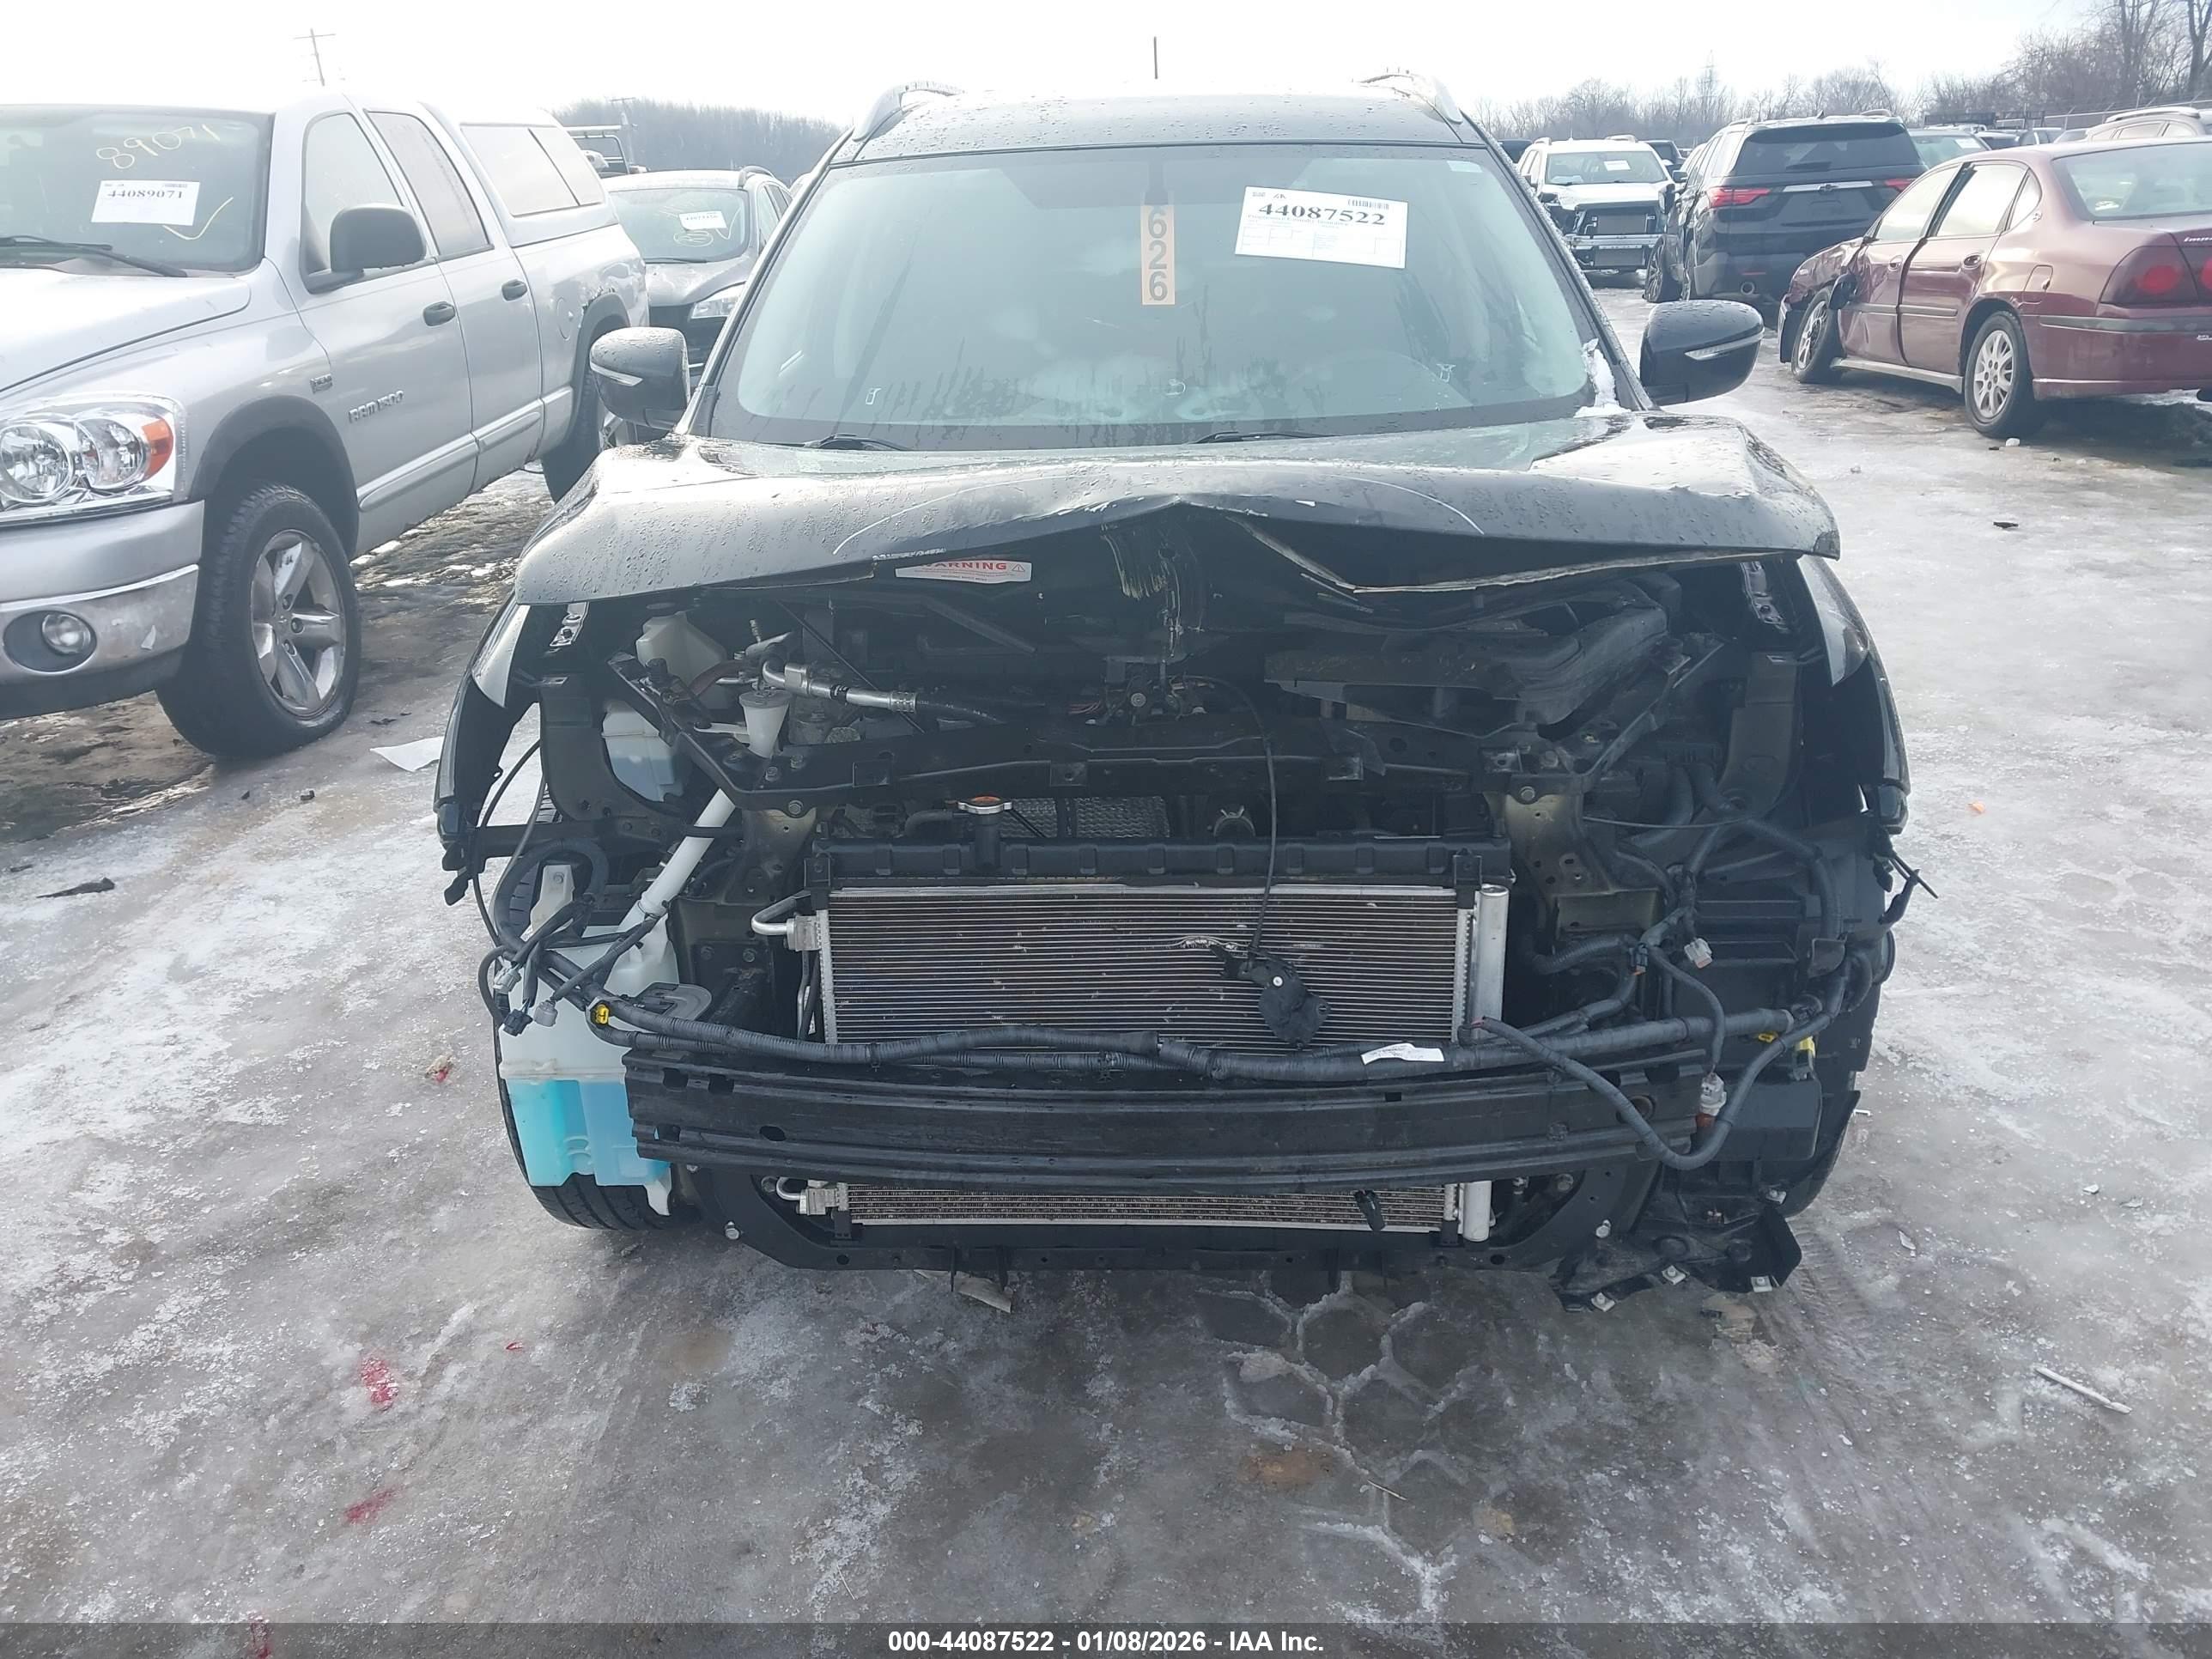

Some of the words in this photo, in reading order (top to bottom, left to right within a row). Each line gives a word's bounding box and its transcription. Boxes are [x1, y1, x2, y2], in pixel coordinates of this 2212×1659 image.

[96, 124, 221, 169] 89071
[106, 189, 184, 199] 44089071
[1258, 203, 1386, 226] 44087522
